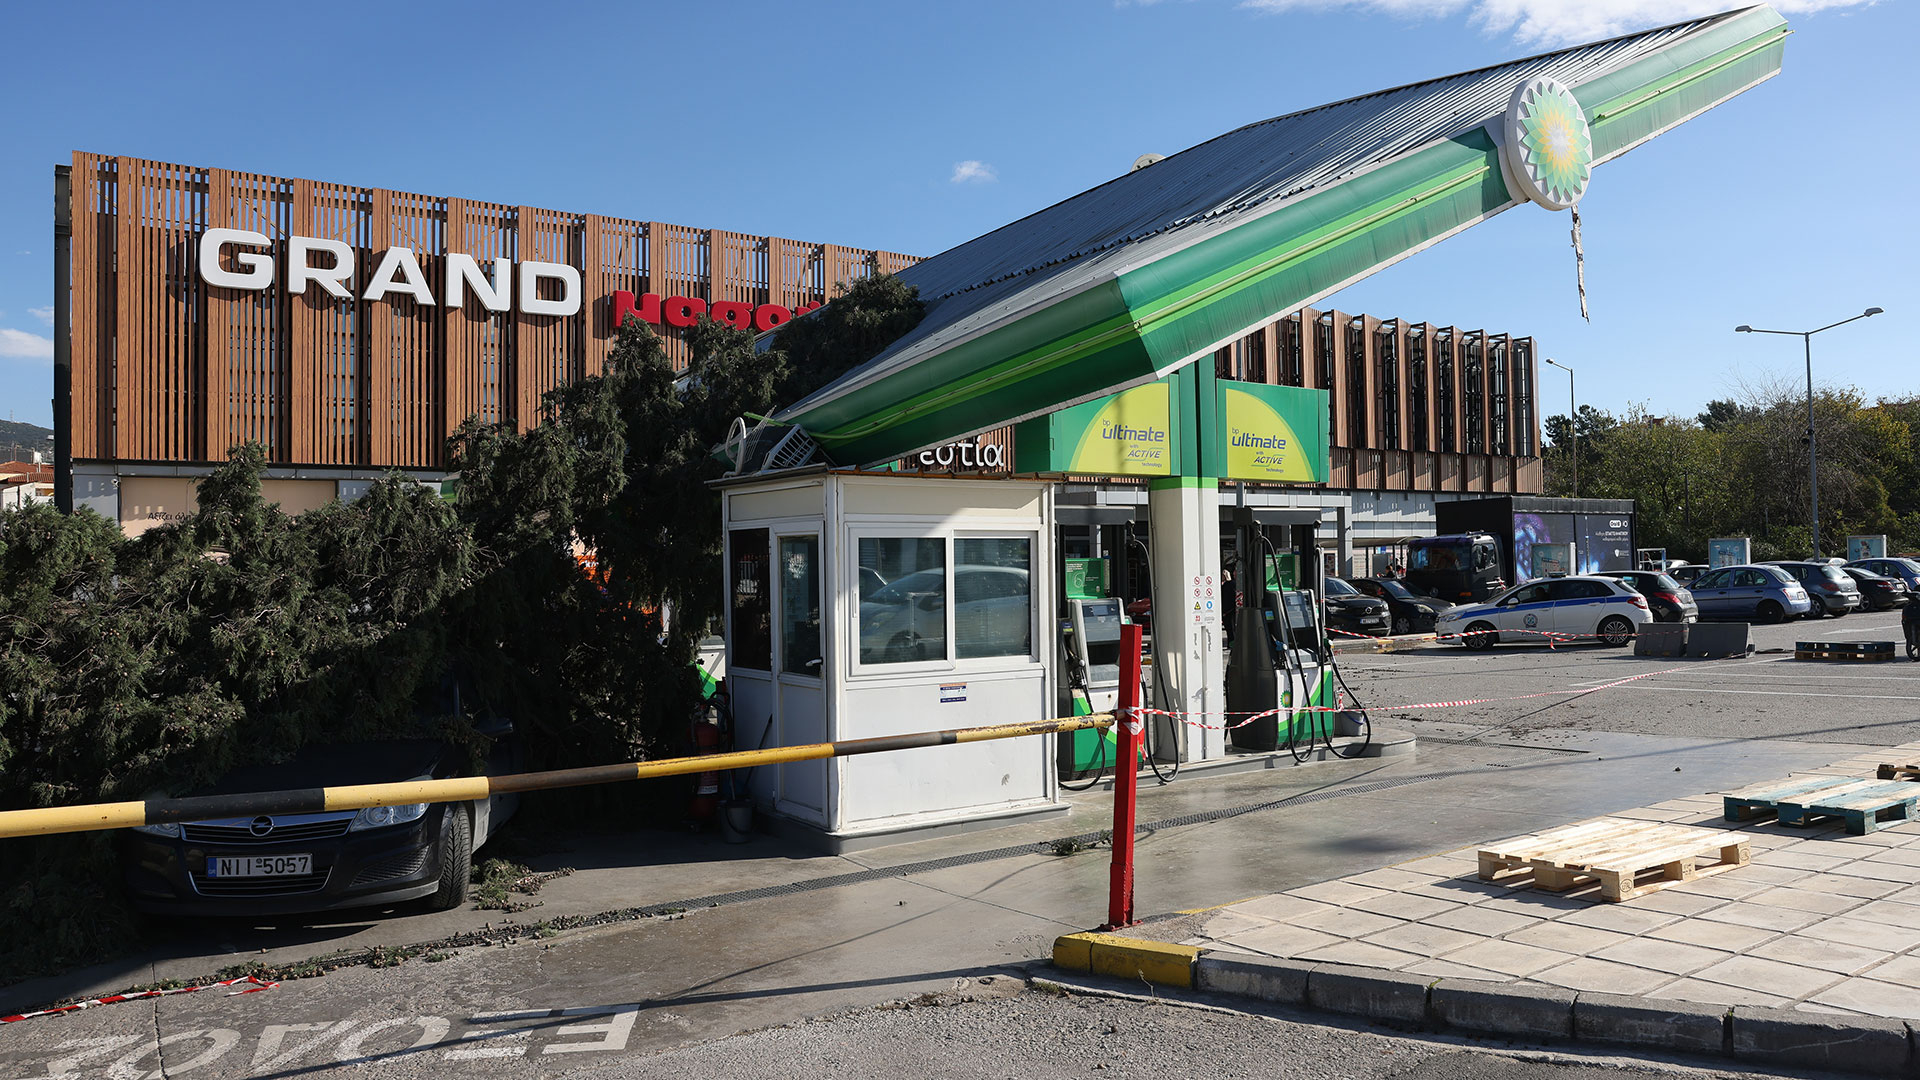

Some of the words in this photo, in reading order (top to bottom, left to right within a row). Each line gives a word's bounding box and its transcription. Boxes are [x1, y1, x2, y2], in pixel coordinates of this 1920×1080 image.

[200, 228, 580, 316] GRAND
[613, 290, 821, 331] Μασο
[1102, 418, 1111, 427] bp
[1102, 424, 1165, 442] ultimate
[1231, 432, 1287, 450] ultimate
[1127, 449, 1162, 459] ACTIVE
[1253, 456, 1284, 465] ACTIVE
